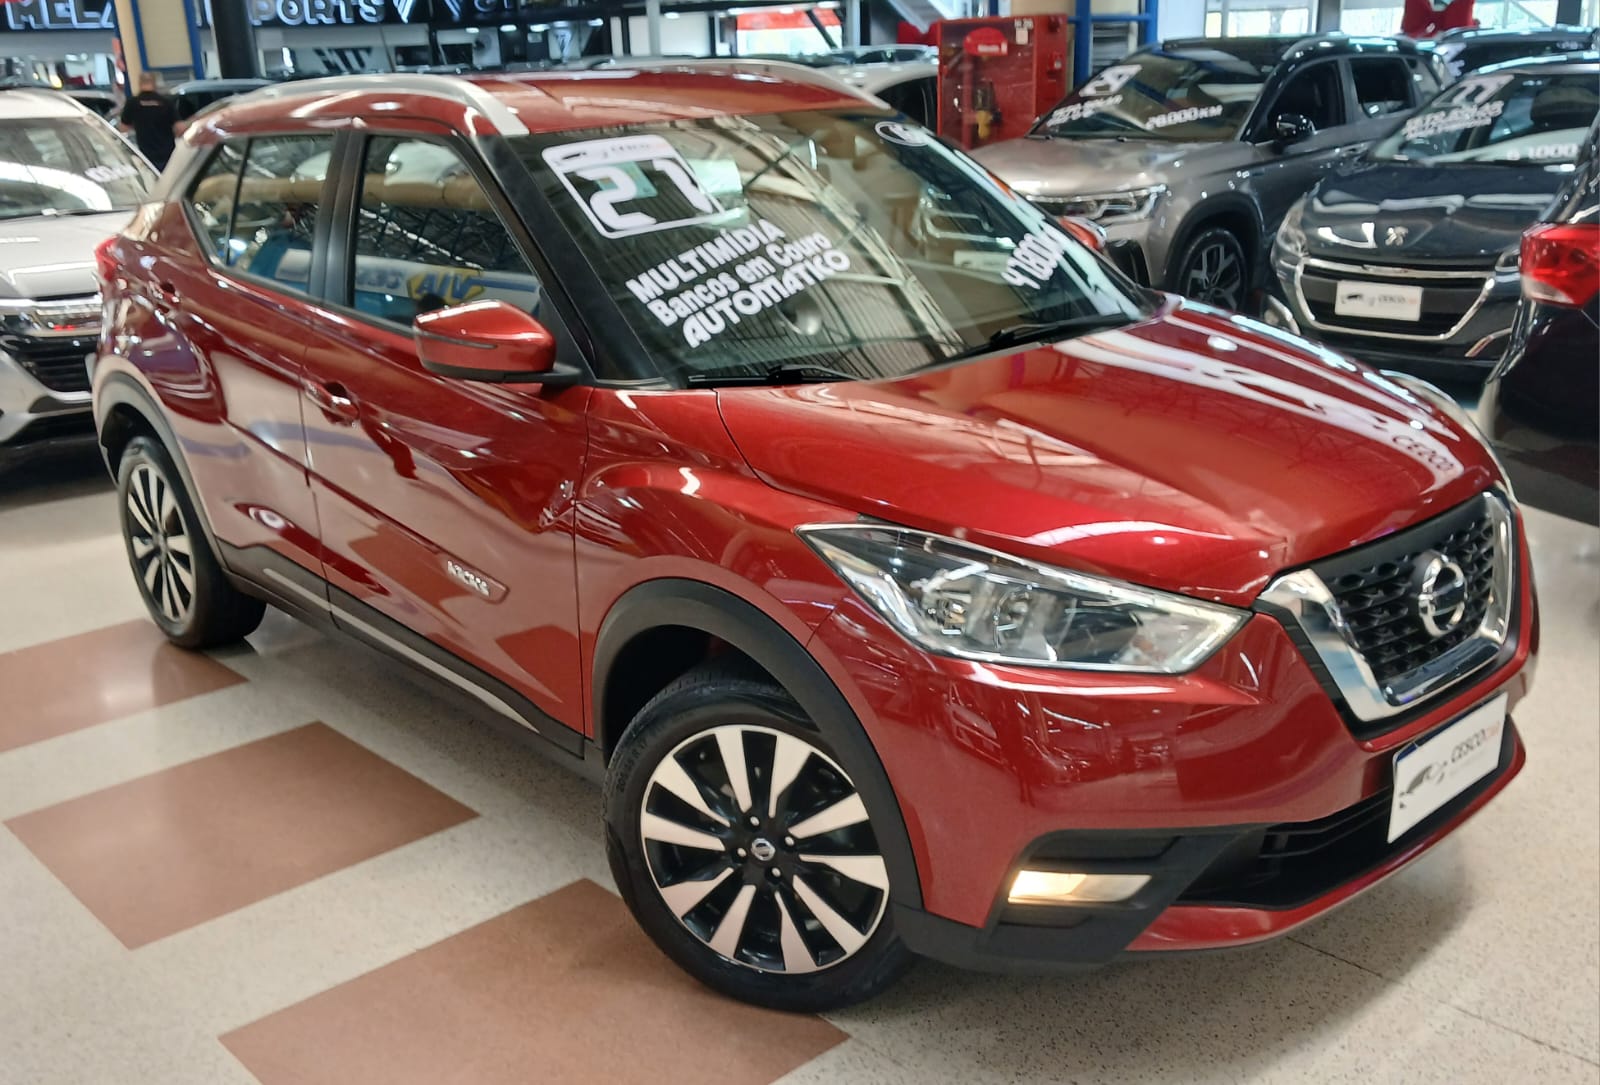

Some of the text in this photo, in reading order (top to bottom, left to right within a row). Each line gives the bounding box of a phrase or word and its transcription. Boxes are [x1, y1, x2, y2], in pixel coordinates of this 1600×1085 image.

[647, 232, 832, 327] Bancos em Couro
